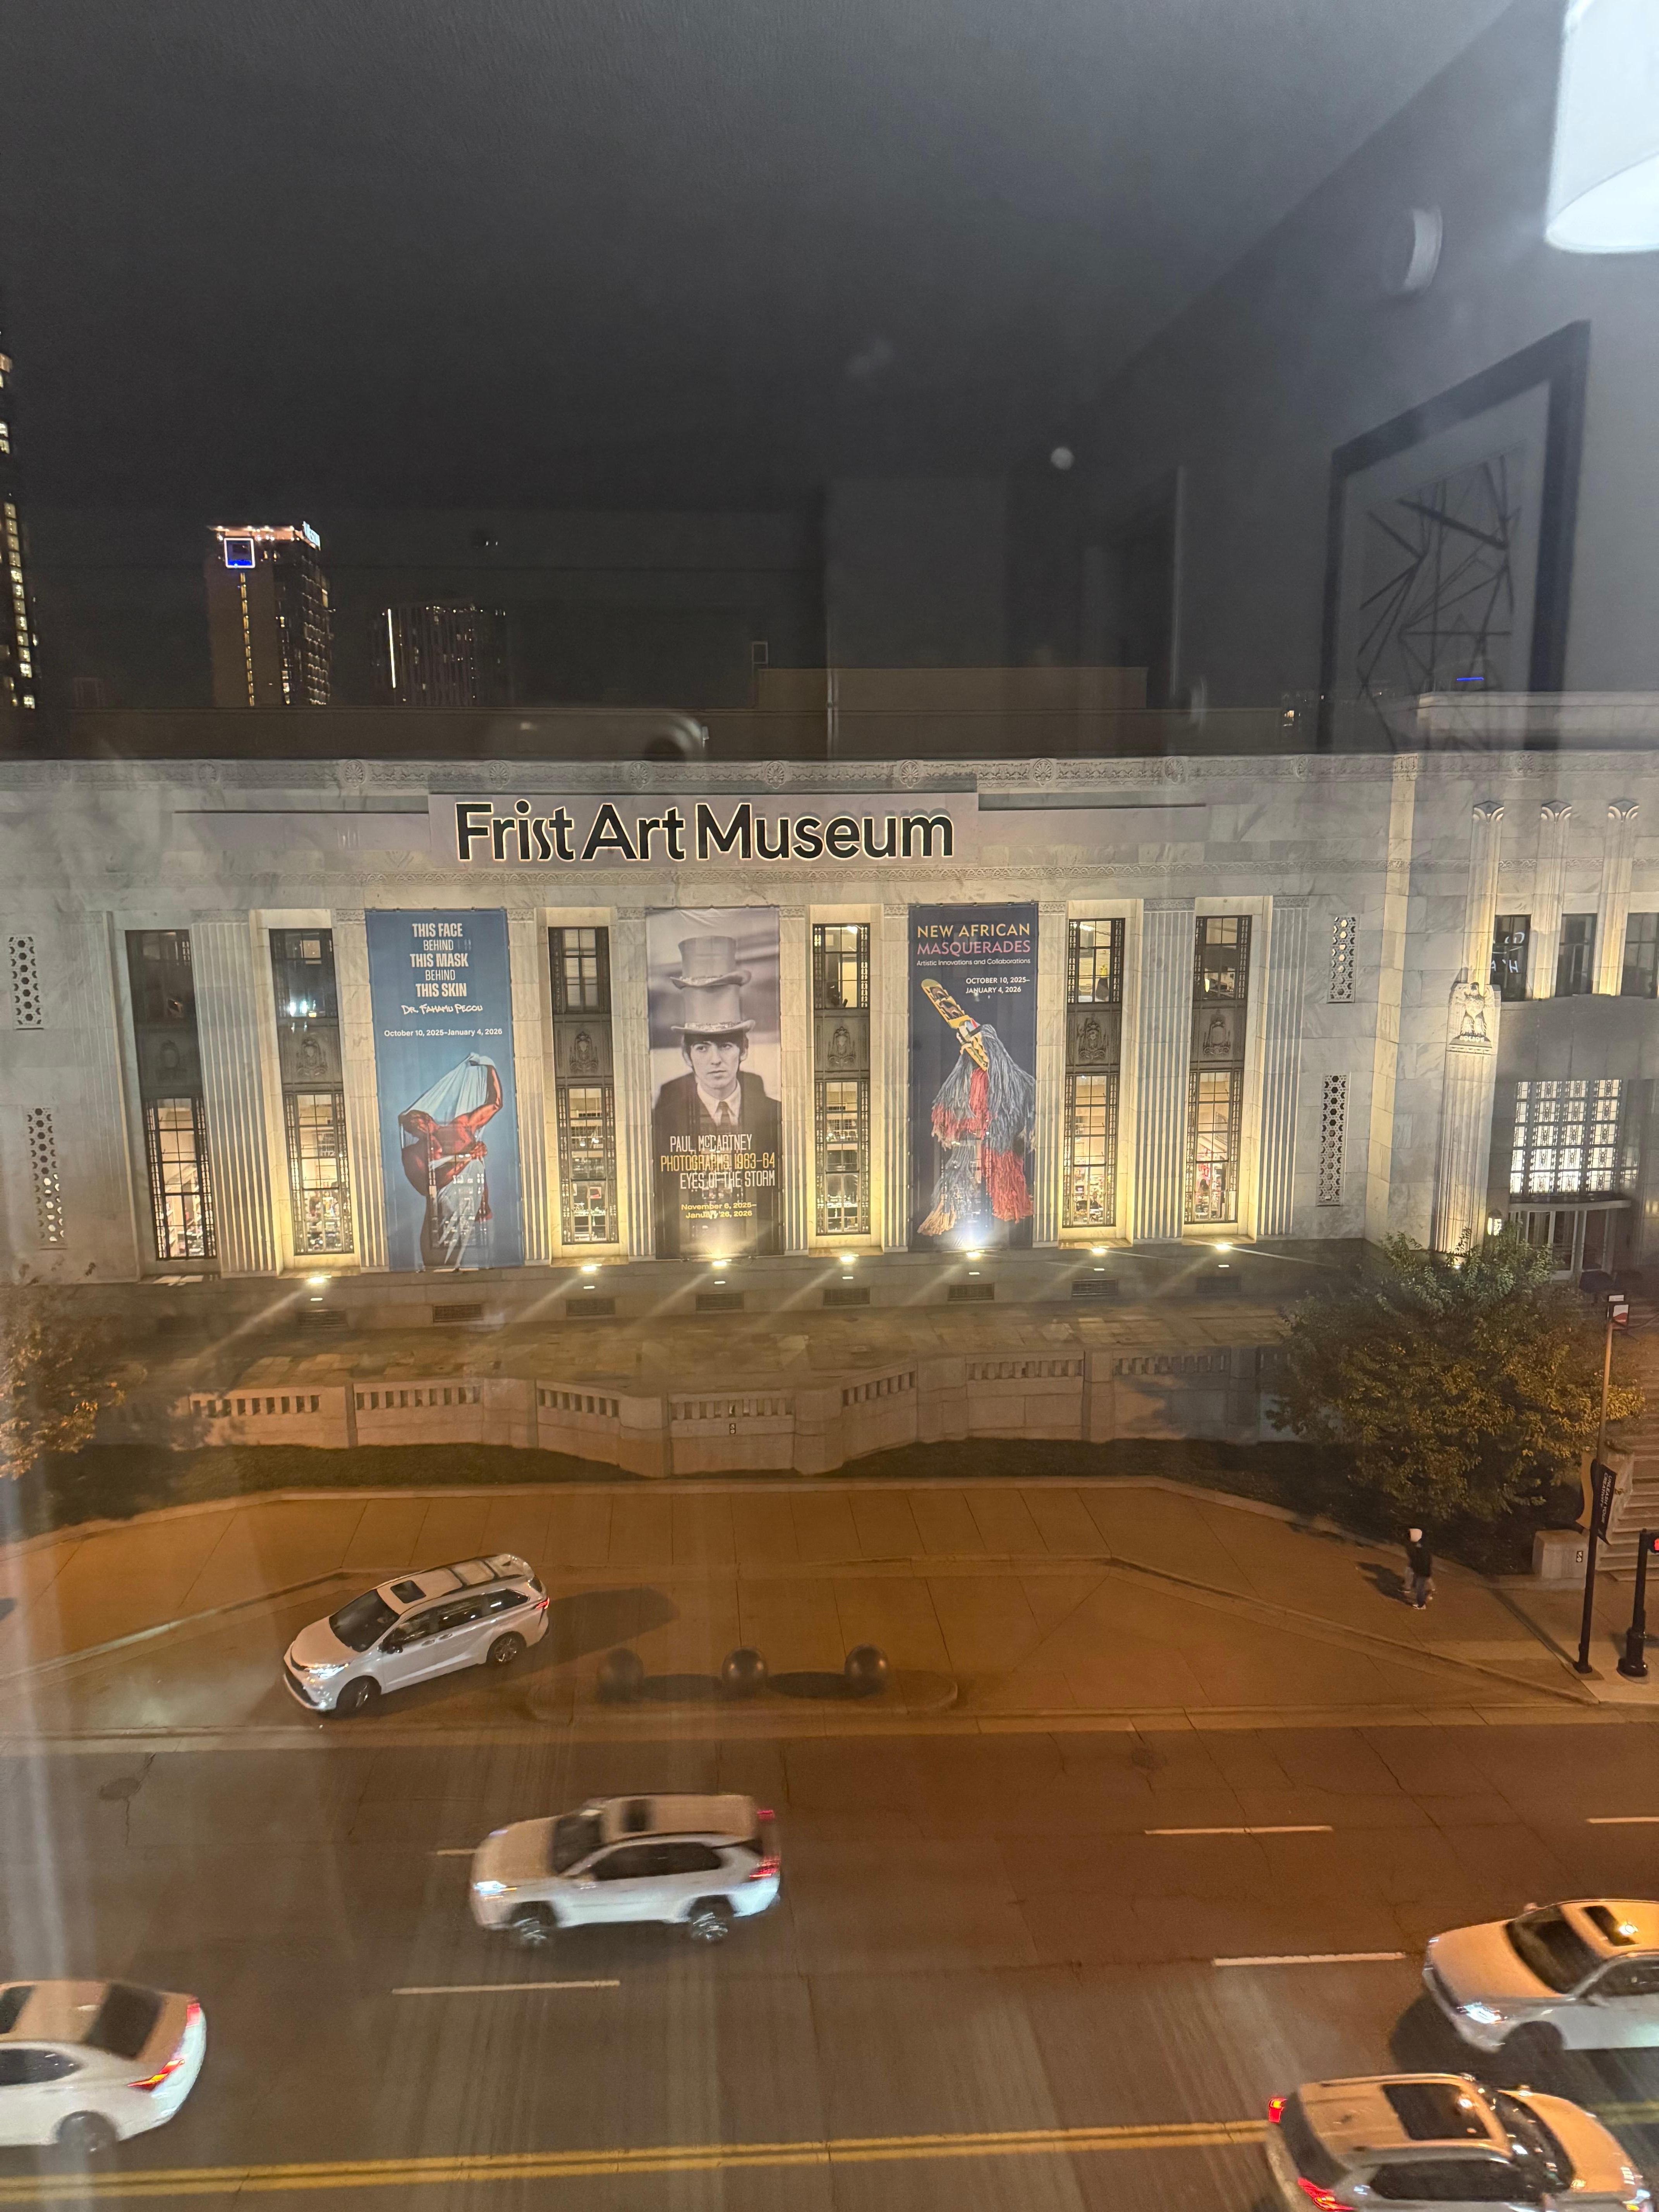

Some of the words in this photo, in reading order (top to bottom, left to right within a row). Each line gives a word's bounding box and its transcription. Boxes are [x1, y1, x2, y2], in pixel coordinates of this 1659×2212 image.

[455, 799, 575, 861] Frist
[581, 802, 686, 861] Art
[696, 803, 954, 860] Museum
[412, 923, 435, 937] THIS
[438, 923, 463, 937] FACE
[917, 925, 953, 938] NEW
[958, 923, 1030, 937] AFRICAN
[423, 939, 453, 951] BEHIND
[917, 940, 1030, 957] MASQUERADES
[410, 953, 433, 967] THIS
[436, 953, 469, 967] MASK
[425, 969, 455, 981] BEHIND
[416, 983, 439, 997] THIS
[441, 983, 467, 997] SKIN
[670, 1135, 695, 1152] PAUL
[661, 1154, 730, 1172] PHOTOGRAPHS
[680, 1172, 704, 1189] EYES
[709, 1171, 719, 1188] OF
[723, 1171, 742, 1188] THE
[745, 1170, 775, 1187] STORM
